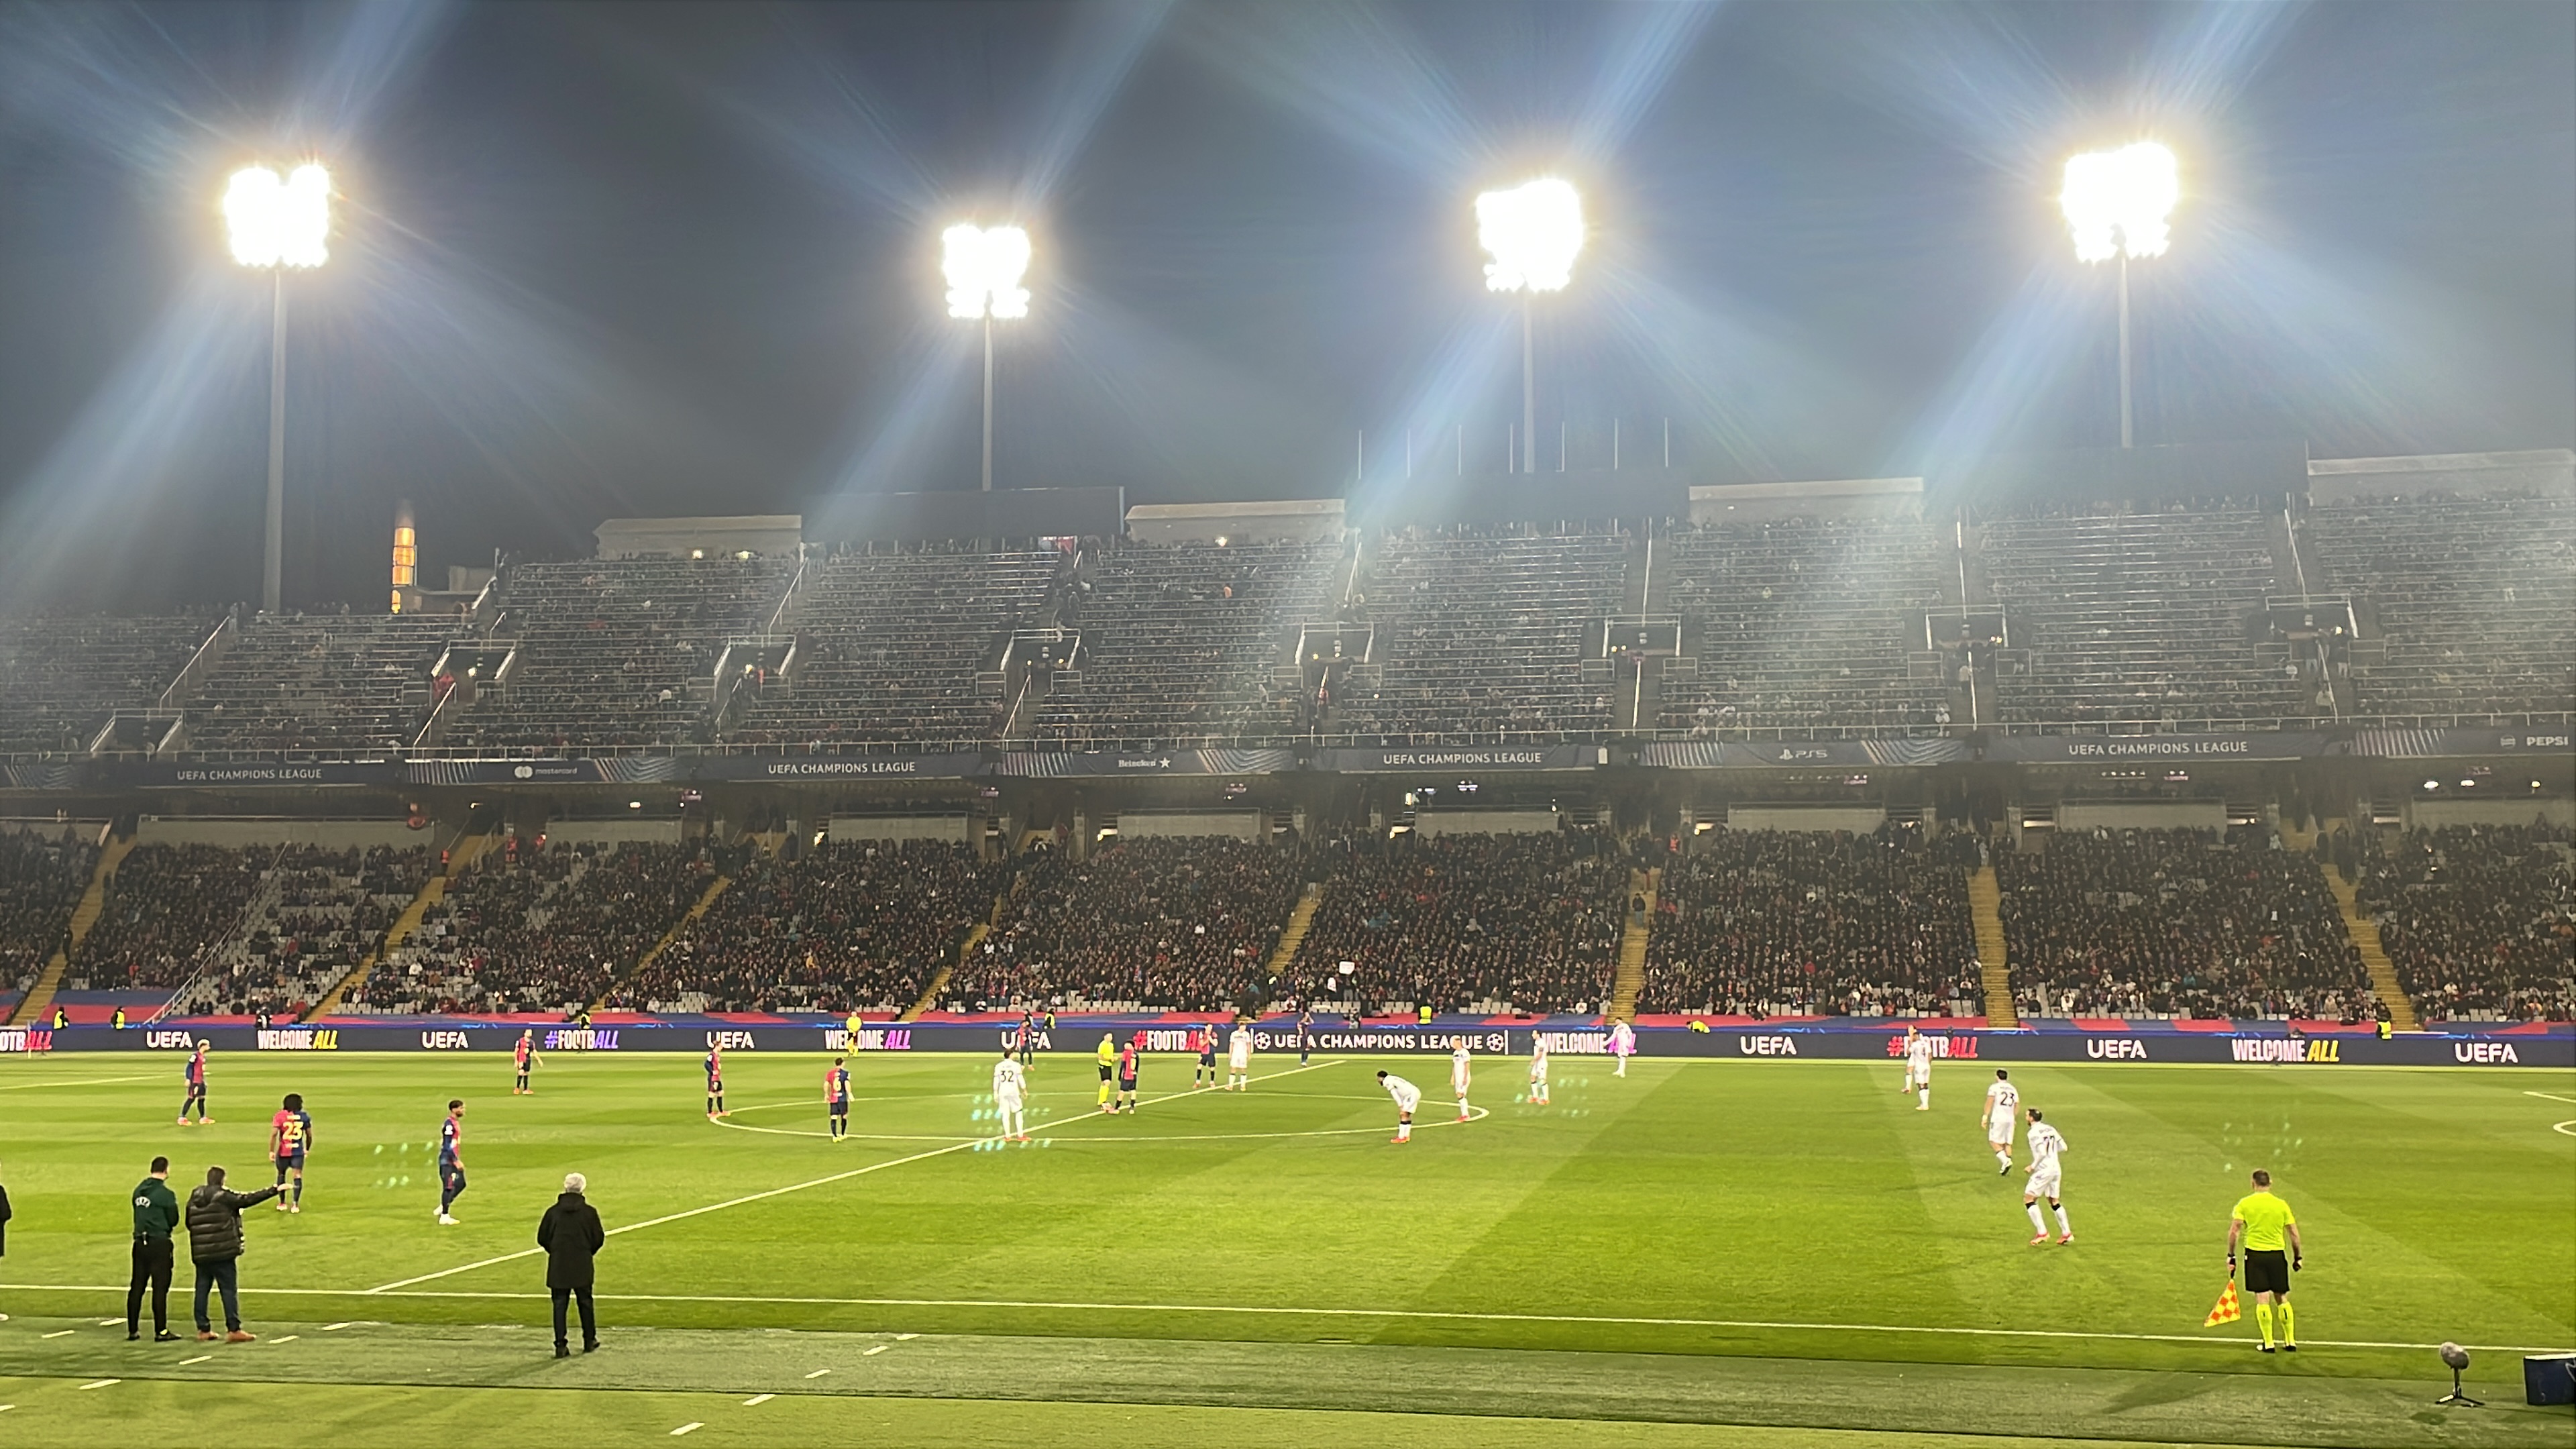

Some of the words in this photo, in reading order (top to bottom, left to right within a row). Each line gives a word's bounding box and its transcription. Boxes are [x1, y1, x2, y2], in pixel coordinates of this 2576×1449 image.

[2069, 745, 2105, 755] UEFA
[2108, 743, 2190, 755] CHAMPIONS
[2194, 741, 2248, 753] LEAGUE
[2526, 737, 2569, 747] PEPSI
[1383, 754, 1415, 765] UEFA
[1418, 753, 1491, 764] CHAMPIONS
[1494, 752, 1542, 763] LEAGUE
[1795, 749, 1828, 759] PS5
[768, 763, 798, 774] UEFA
[801, 763, 868, 773] CHAMPIONS
[872, 762, 916, 772] LEAGUE
[1118, 759, 1157, 767] Heineken
[177, 771, 206, 781] UEFA
[209, 769, 275, 780] CHAMPIONS
[279, 769, 322, 779] LEAGUE
[146, 1031, 193, 1049] UEFA
[257, 1030, 313, 1050] WELCOME
[313, 1030, 338, 1050] ALL
[422, 1031, 468, 1049] UEFA
[544, 1030, 619, 1050] #FOOTBALL
[706, 1031, 755, 1049] UEFA
[824, 1030, 885, 1050] WELOME
[883, 1030, 911, 1050] ALL
[1320, 1034, 1415, 1049] CHAMPIONS
[1740, 1036, 1797, 1055] UEFA
[2087, 1039, 2147, 1059] UEFA
[2231, 1039, 2306, 1062] WELCOME
[2306, 1039, 2341, 1063] ALL
[2455, 1042, 2518, 1063] UEFA
[833, 1076, 842, 1092] 6
[1000, 1070, 1014, 1083] 32
[2000, 1091, 2015, 1107] 23
[282, 1121, 304, 1140] 23
